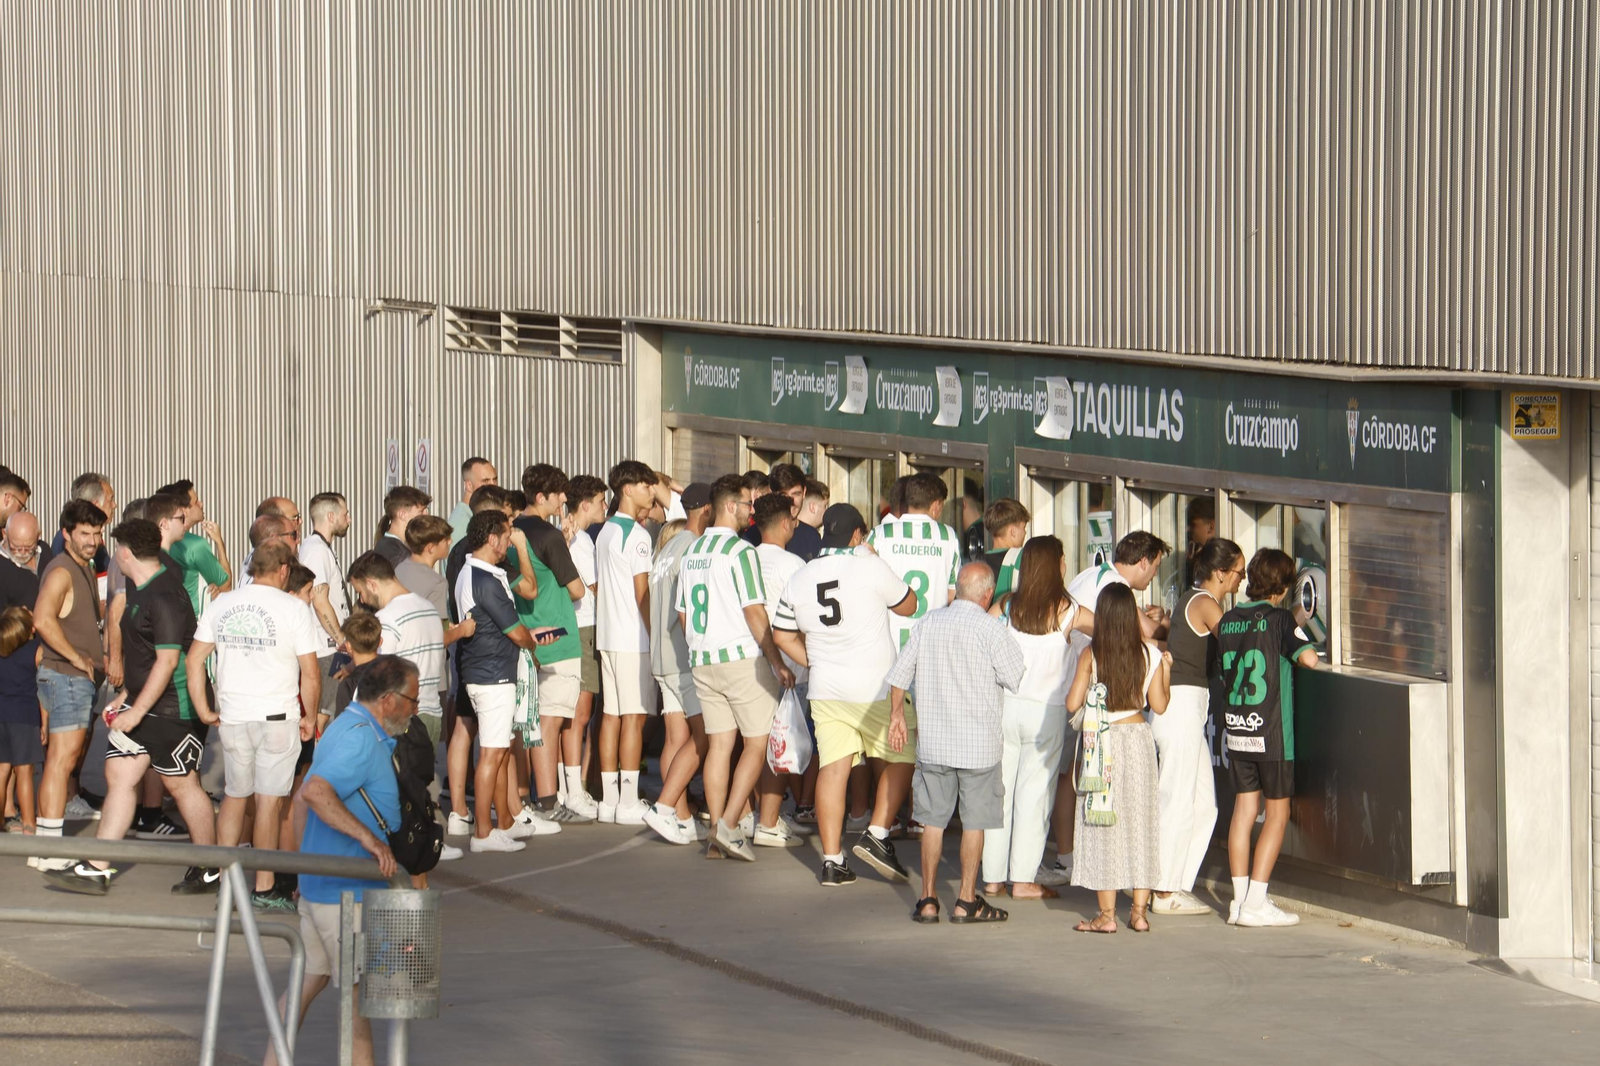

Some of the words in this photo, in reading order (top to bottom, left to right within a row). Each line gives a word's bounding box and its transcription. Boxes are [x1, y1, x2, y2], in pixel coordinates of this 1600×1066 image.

[730, 368, 740, 390] CF
[785, 369, 824, 398] rg3print.es
[876, 370, 932, 420] Cruzcampo
[974, 384, 987, 410] RG3
[990, 385, 1033, 416] rg3print.es
[1072, 382, 1184, 442] TAQUILLAS
[1225, 401, 1298, 458] Cruzcampo
[1421, 425, 1436, 454] CF
[687, 558, 712, 570] GUDELJ
[892, 542, 942, 556] CALDERÓN
[691, 583, 709, 634] 8
[816, 580, 843, 628] 5
[1223, 649, 1267, 706] 23
